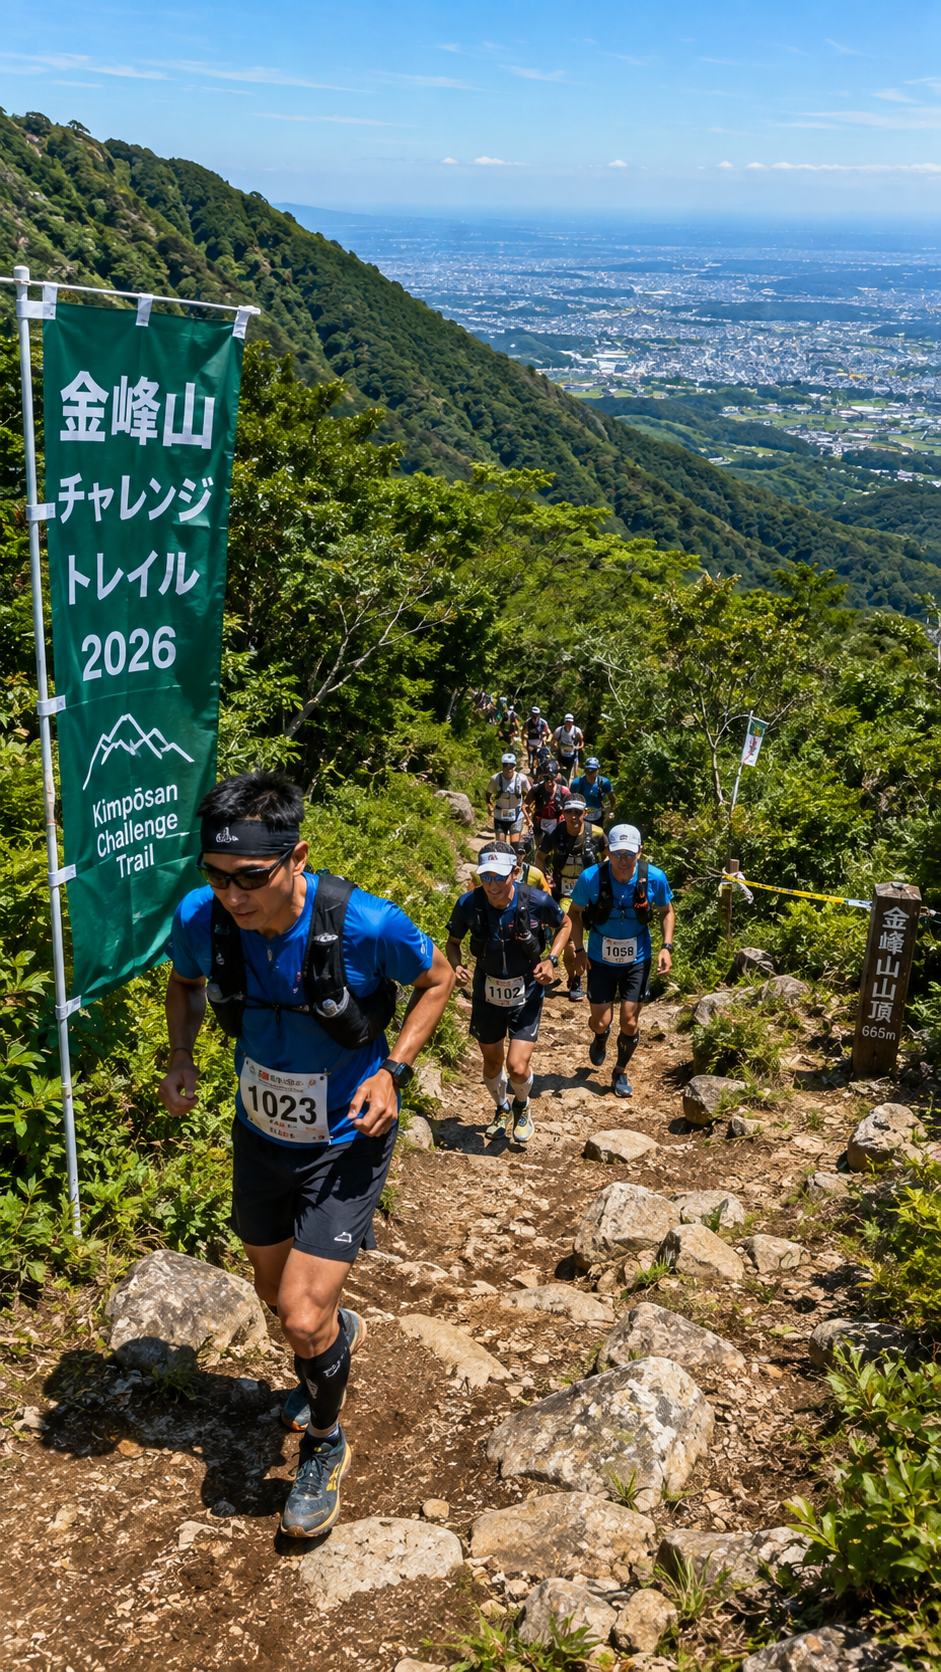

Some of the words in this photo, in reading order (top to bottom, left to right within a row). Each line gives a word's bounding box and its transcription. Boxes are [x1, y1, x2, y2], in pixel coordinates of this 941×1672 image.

[60, 370, 216, 450] 金峰山
[58, 472, 214, 524] チャレンジ
[68, 550, 200, 605] トレイル
[81, 625, 177, 682] 2026
[92, 784, 178, 828] Kimpōsan
[97, 813, 178, 858] Challenge
[116, 843, 155, 879] Trail
[867, 905, 910, 1024] 金峰山山頂
[489, 986, 524, 1000] 1102
[248, 1085, 317, 1125] 1023
